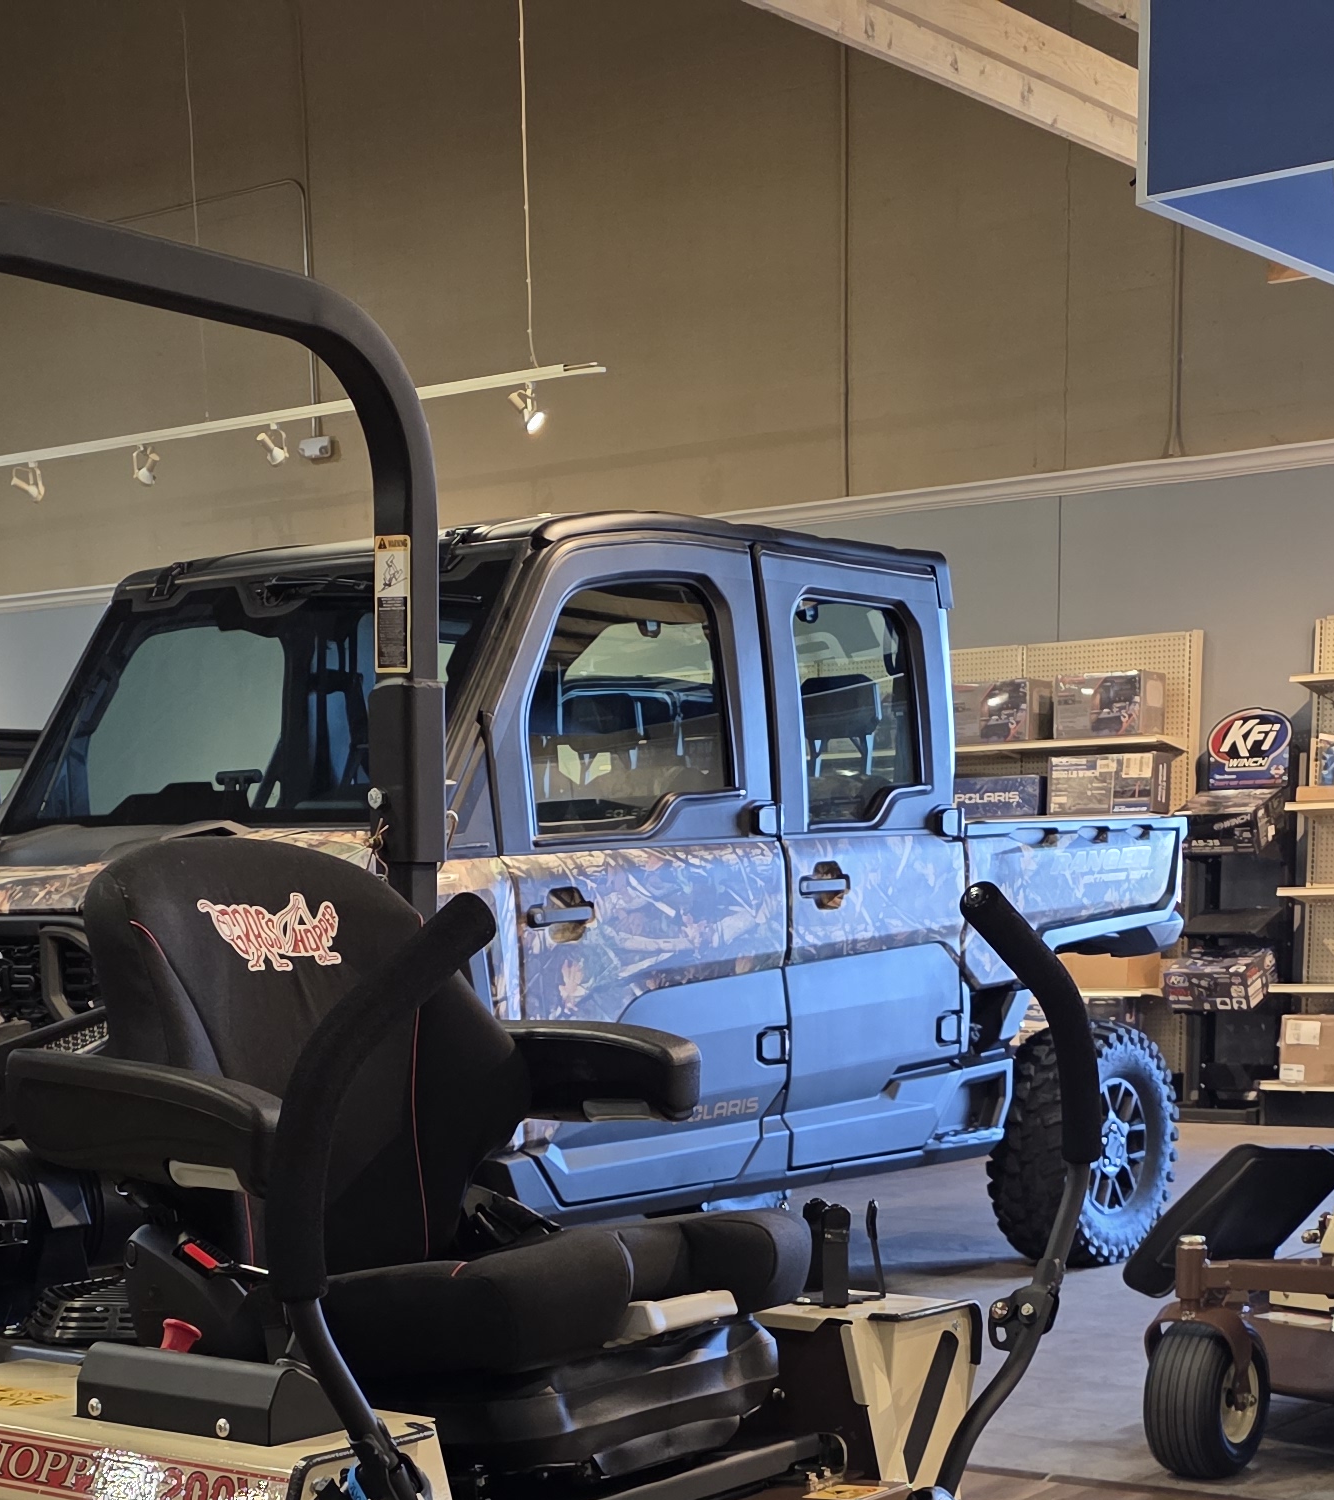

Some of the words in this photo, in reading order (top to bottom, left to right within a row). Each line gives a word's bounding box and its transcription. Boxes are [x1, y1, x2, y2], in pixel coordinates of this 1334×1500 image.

[1228, 757, 1268, 768] WINCH
[954, 791, 1020, 804] POLARIS
[1050, 846, 1152, 875] RANGER
[672, 1097, 759, 1125] OLARIS
